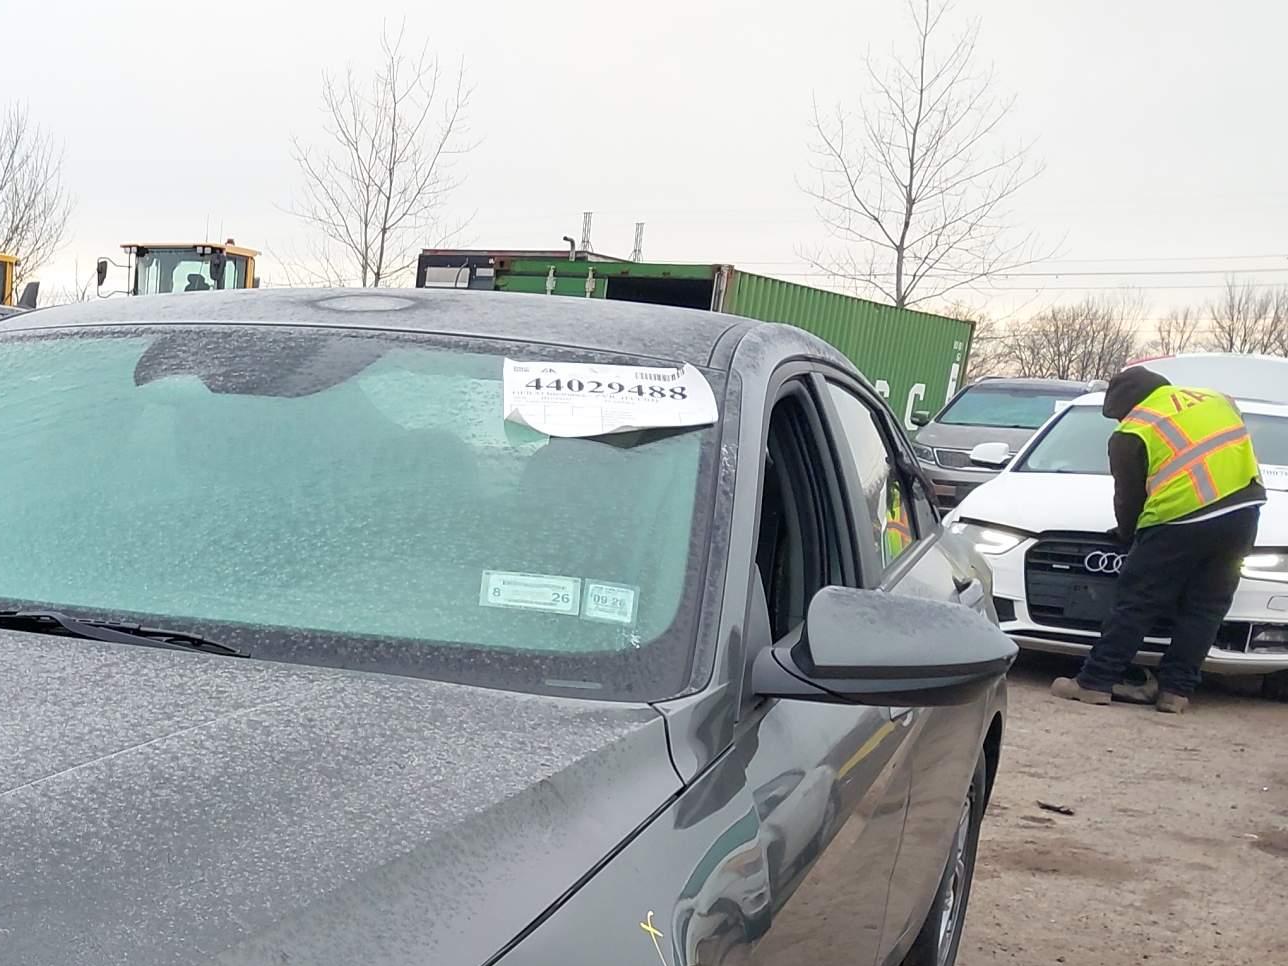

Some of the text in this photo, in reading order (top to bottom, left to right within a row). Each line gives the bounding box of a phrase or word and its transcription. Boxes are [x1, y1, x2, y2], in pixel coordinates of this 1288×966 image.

[525, 377, 688, 401] 44029488
[492, 587, 501, 597] 8
[552, 592, 570, 604] 26
